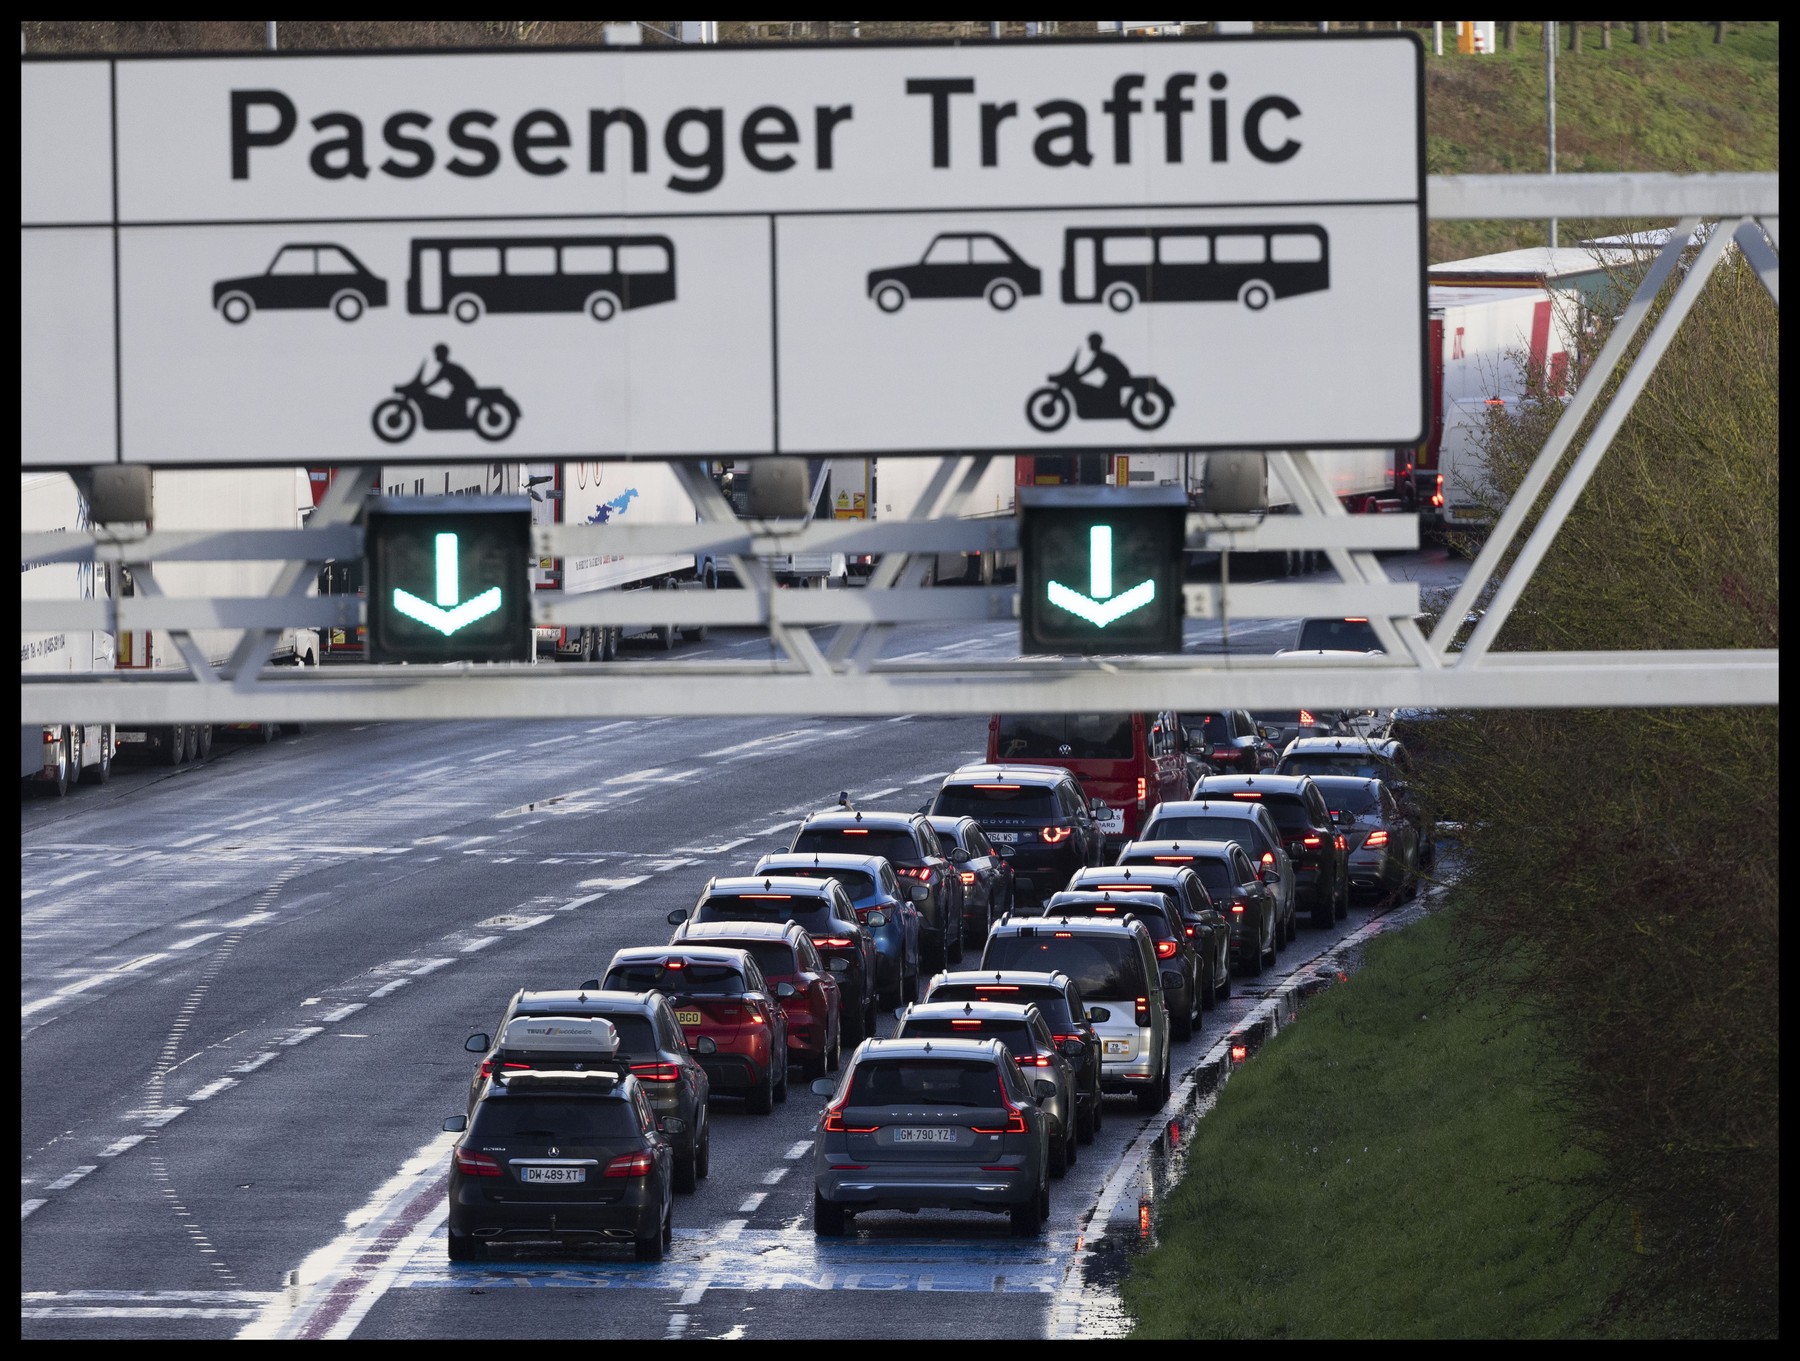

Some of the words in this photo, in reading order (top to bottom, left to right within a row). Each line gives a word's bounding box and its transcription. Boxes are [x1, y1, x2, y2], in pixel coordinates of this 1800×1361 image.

[229, 88, 854, 195] Passenger
[905, 72, 1303, 169] Traffic
[901, 1129, 949, 1140] GM-790-YZ
[529, 1169, 578, 1180] DW-489-XT
